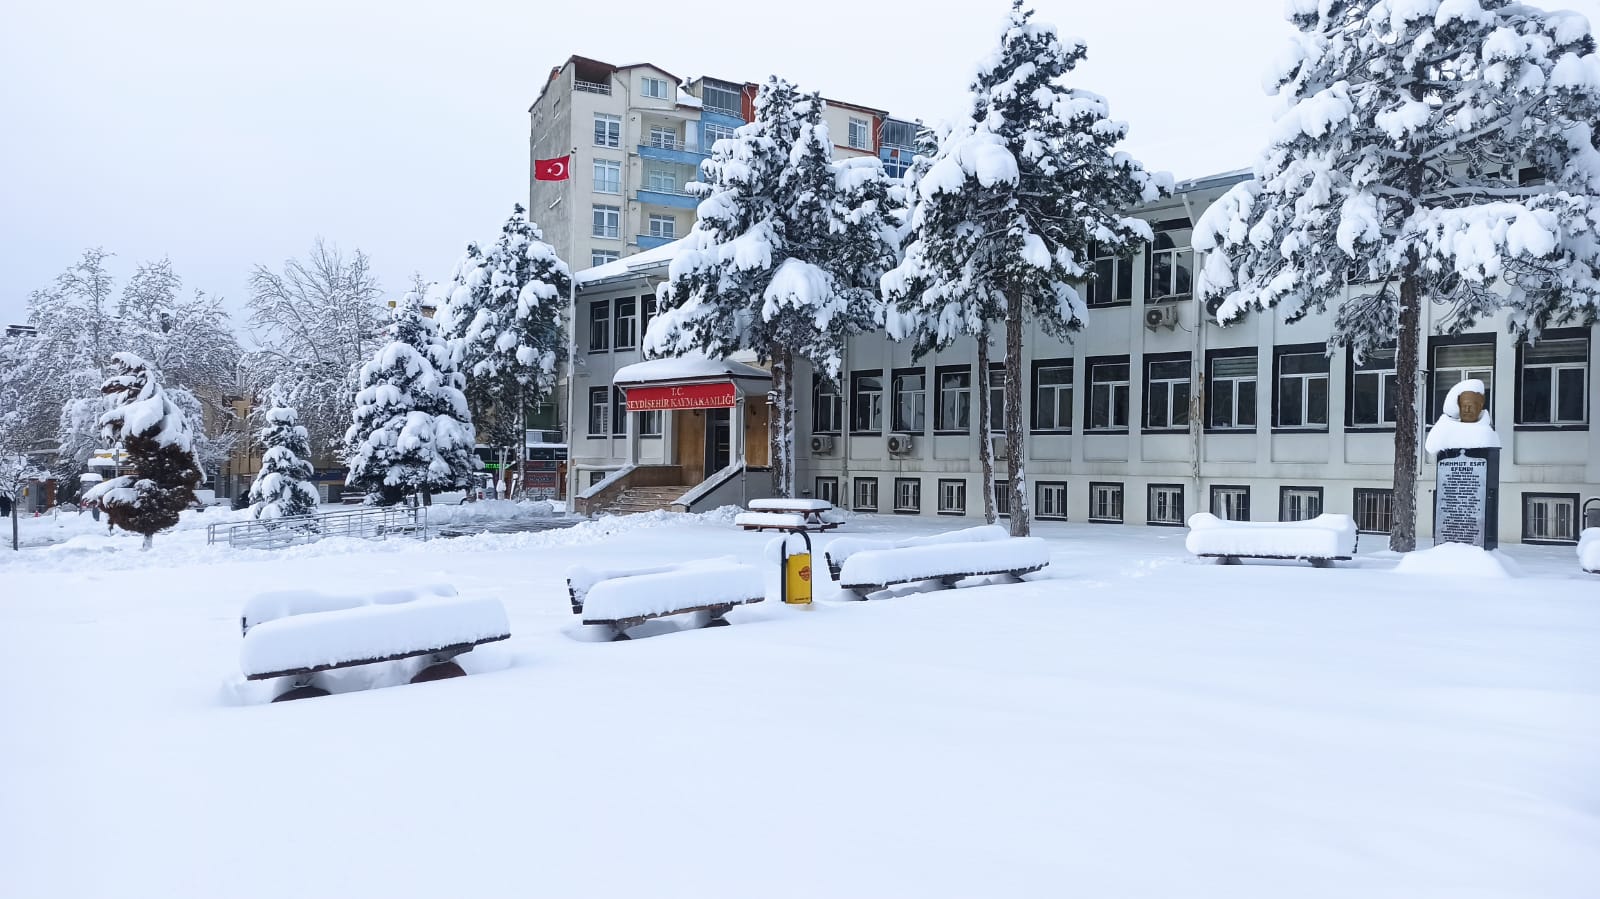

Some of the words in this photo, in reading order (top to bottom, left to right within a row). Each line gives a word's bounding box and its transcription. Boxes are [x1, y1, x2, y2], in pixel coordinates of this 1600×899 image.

[671, 388, 684, 396] T.C.
[626, 397, 669, 409] SEYDİŞEHİR
[670, 393, 735, 408] KAYMAKAMLIĞI
